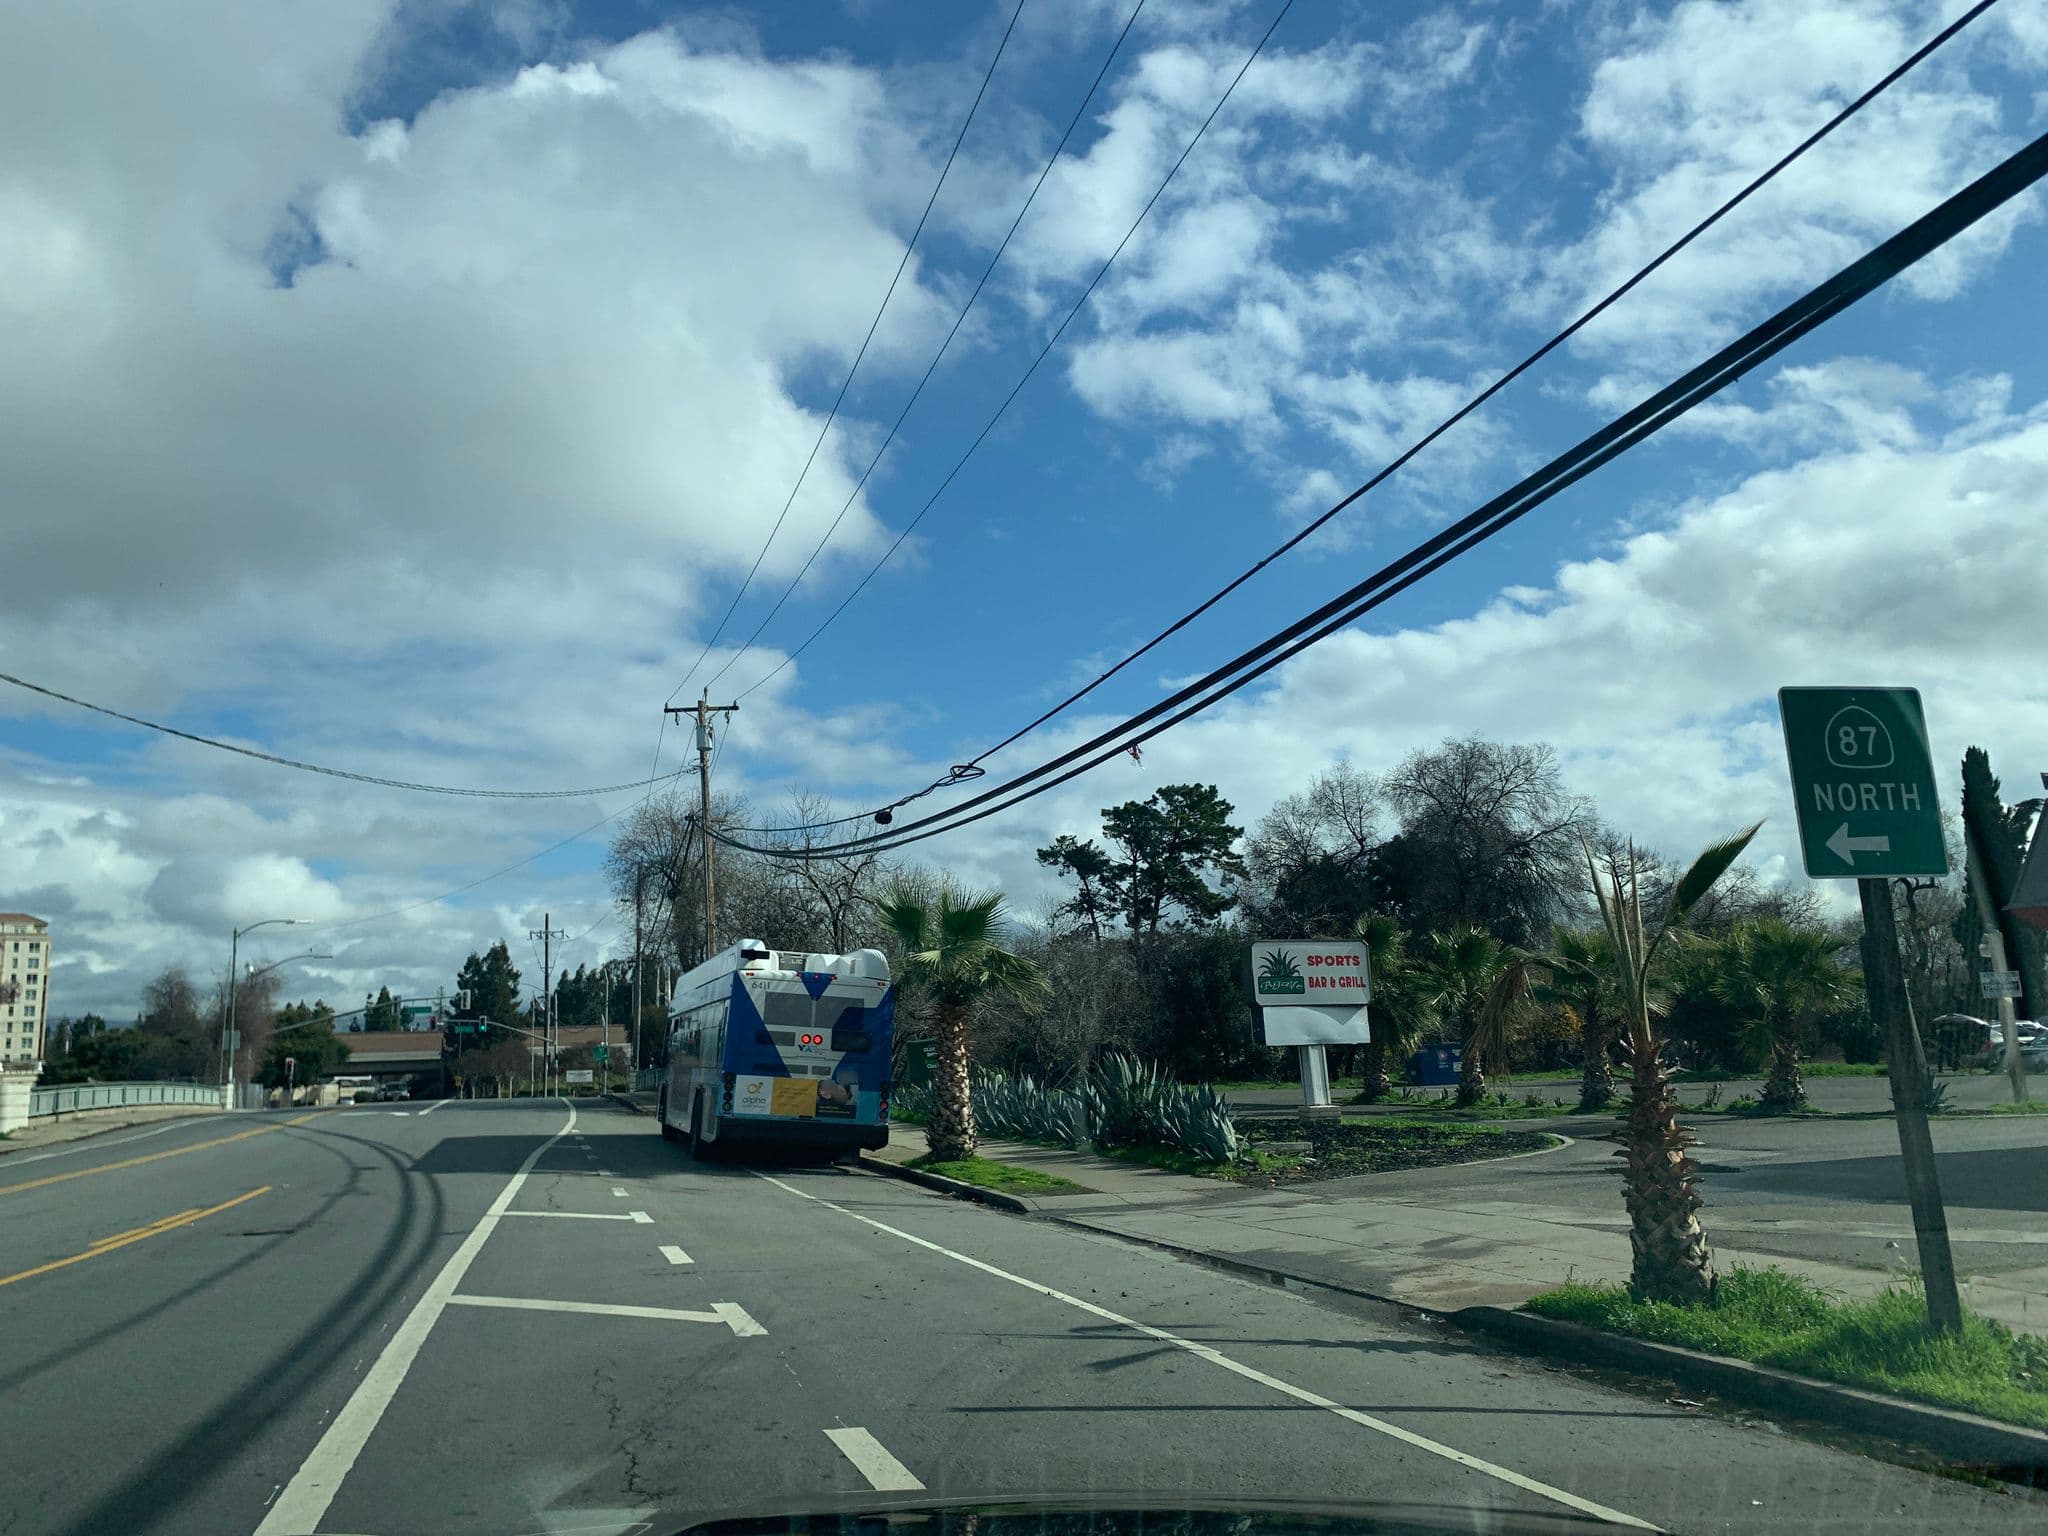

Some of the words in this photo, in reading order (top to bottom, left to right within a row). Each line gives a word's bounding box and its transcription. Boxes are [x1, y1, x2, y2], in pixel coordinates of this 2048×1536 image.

[1839, 726, 1877, 755] 87
[1813, 783, 1921, 811] NORTH
[1307, 955, 1360, 966] SPORTS
[1308, 976, 1327, 988] BAR
[1339, 976, 1366, 988] GRILL
[742, 1095, 767, 1104] alpha
